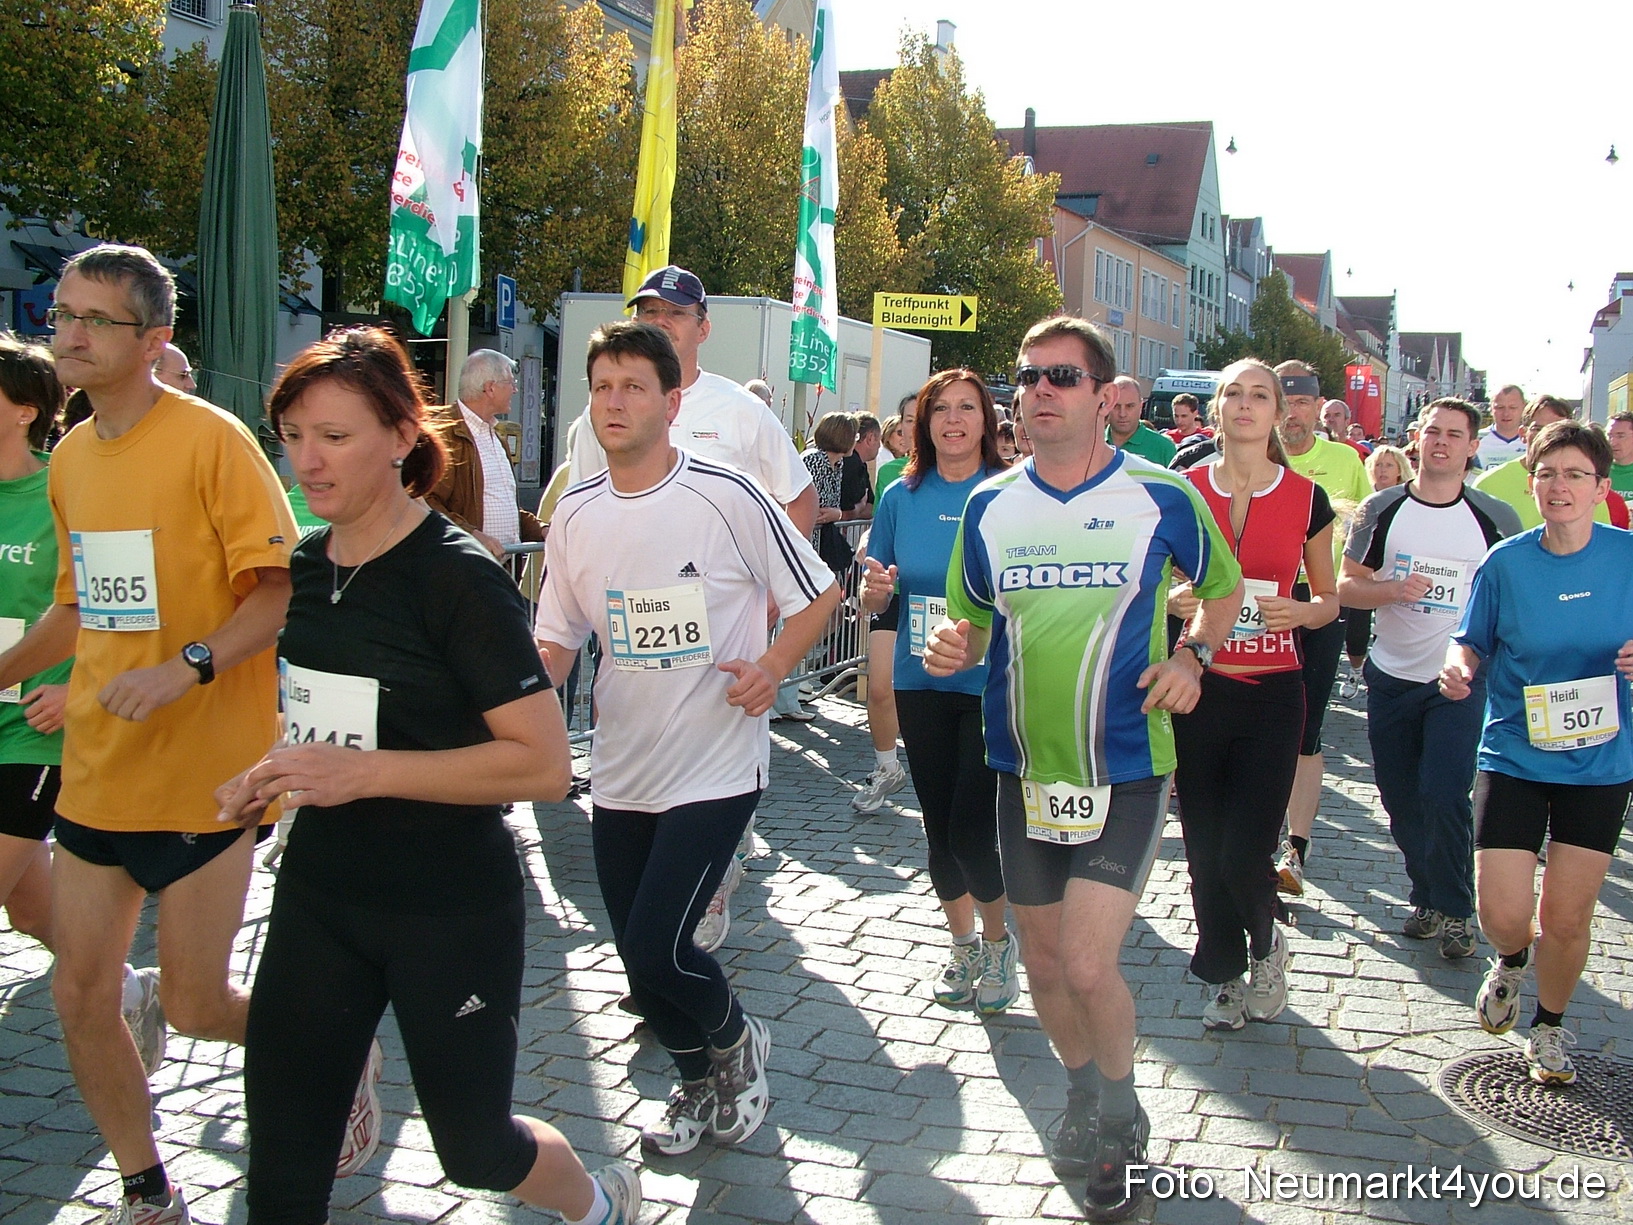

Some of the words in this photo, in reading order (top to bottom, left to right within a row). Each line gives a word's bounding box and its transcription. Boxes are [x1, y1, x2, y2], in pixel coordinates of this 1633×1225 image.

[882, 296, 950, 310] Treffpunkt
[881, 312, 953, 328] Bladenight
[1172, 380, 1211, 389] BOCK
[525, 361, 535, 460] INDIGO
[1006, 545, 1057, 559] TEAM
[999, 562, 1129, 593] BOCK
[1413, 561, 1458, 578] Sebastian
[91, 576, 147, 603] 3565
[628, 598, 670, 613] Tobias
[635, 621, 701, 649] 2218
[672, 652, 711, 664] PFLEIDERER
[289, 677, 310, 703] Lisa
[1550, 688, 1579, 703] Heidi
[1563, 707, 1604, 731] 507
[1049, 795, 1094, 819] 649
